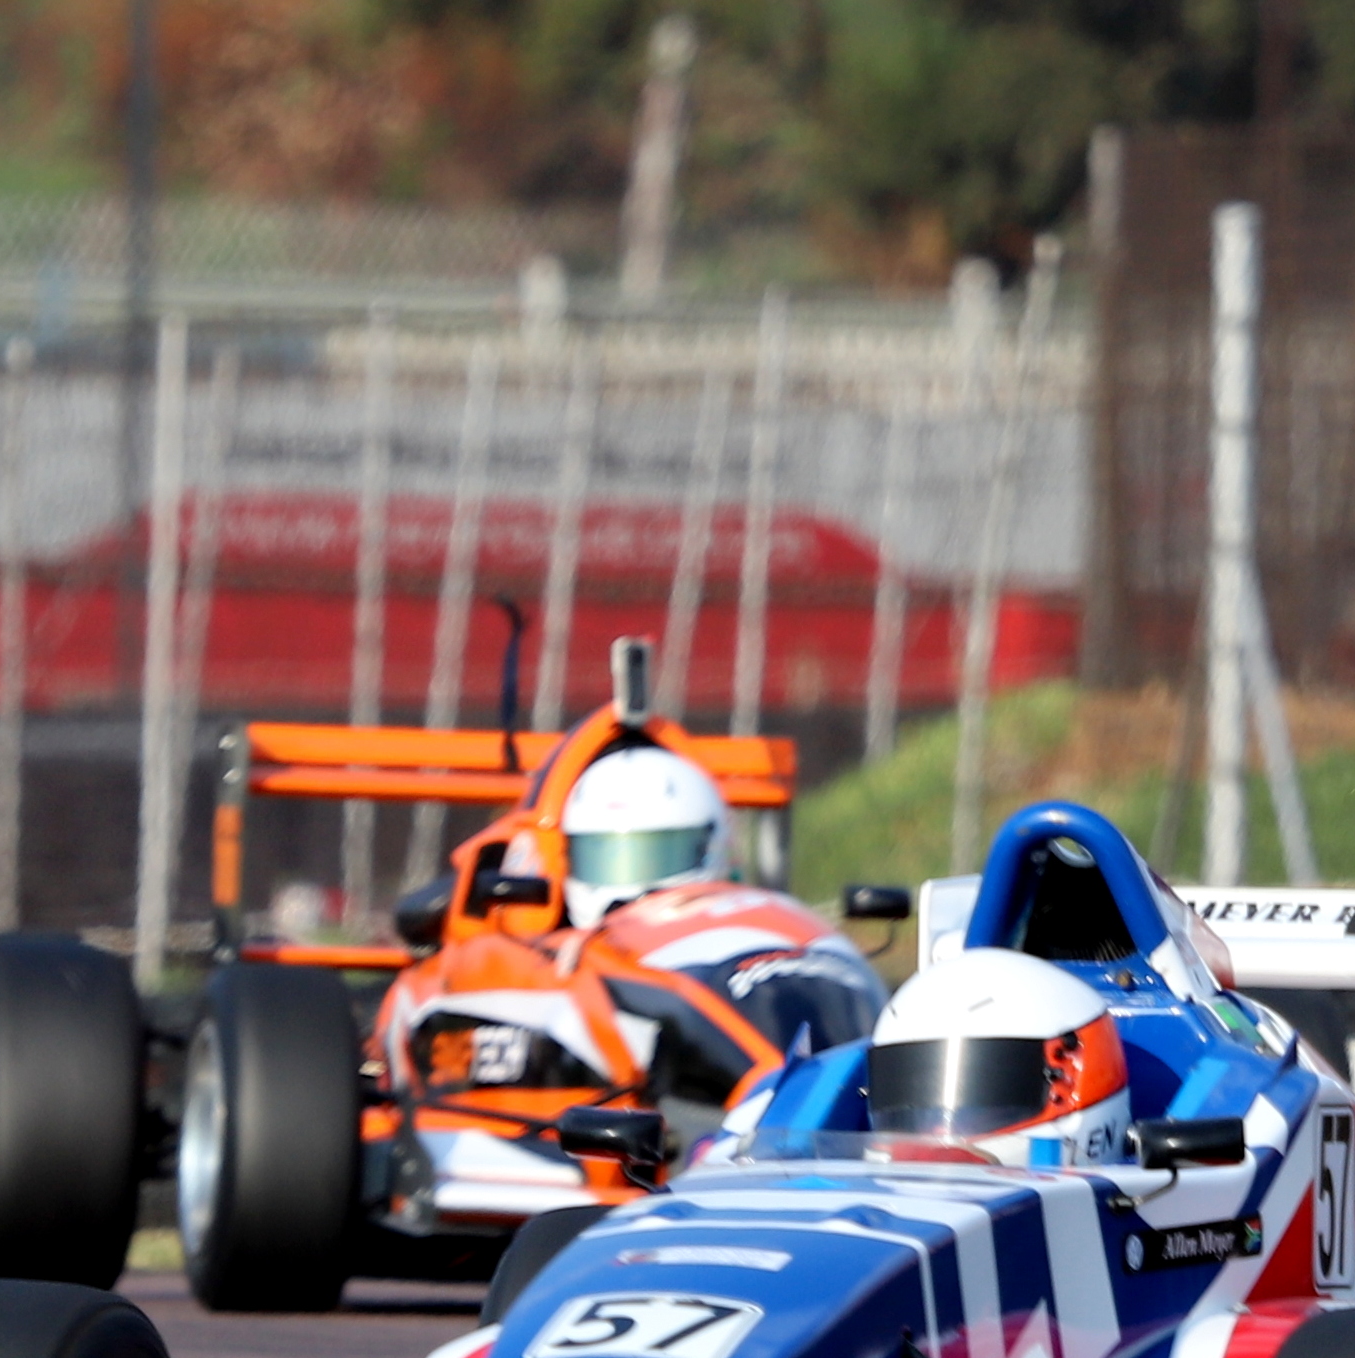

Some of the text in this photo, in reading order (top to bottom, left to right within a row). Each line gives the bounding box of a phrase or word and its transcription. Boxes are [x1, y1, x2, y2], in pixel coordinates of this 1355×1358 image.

[1186, 900, 1320, 925] MEYER
[1317, 1114, 1352, 1279] 57
[1160, 1231, 1197, 1261] Allen
[1198, 1228, 1236, 1262] Meyer
[548, 1298, 742, 1350] 57
